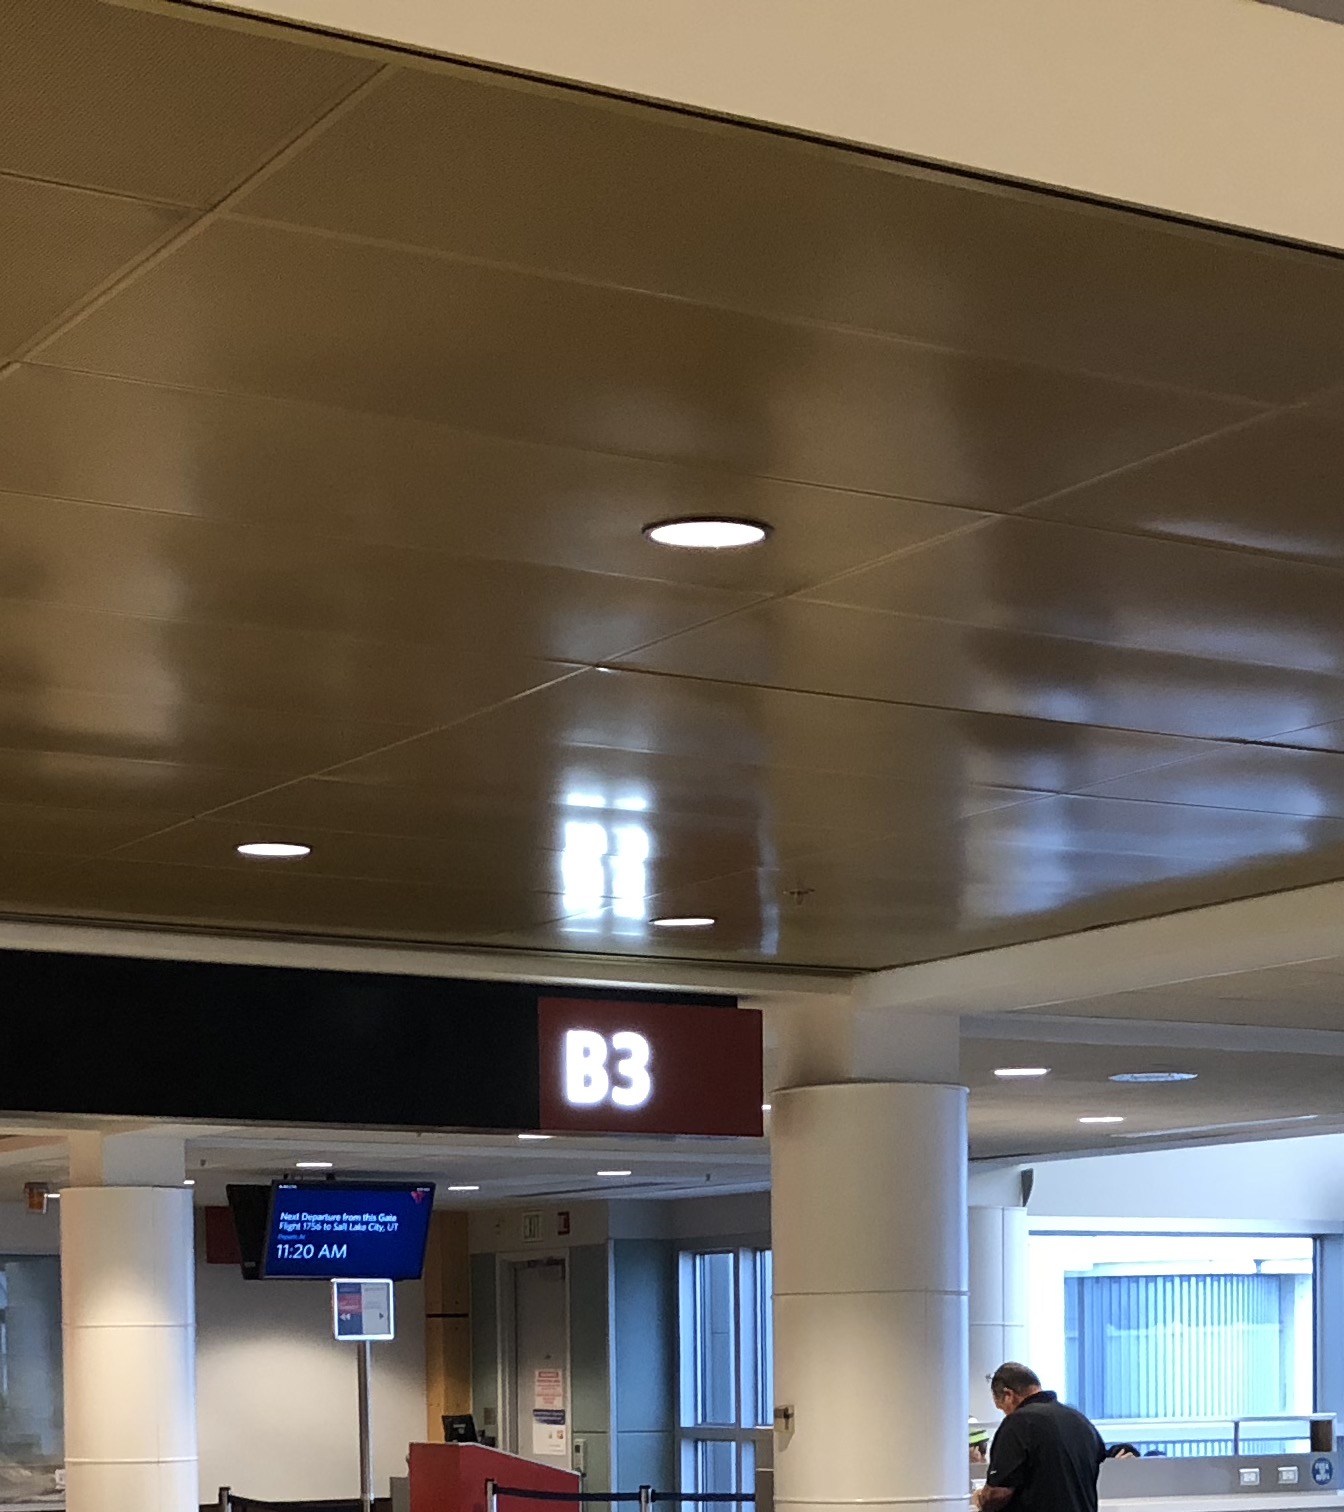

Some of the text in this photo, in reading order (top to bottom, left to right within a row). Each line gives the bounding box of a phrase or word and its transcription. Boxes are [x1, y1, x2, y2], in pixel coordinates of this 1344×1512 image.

[565, 1029, 652, 1107] B3
[280, 1212, 397, 1223] Next Departure from this Gate
[279, 1222, 301, 1232] Flight
[323, 1222, 332, 1231] to
[349, 1222, 367, 1231] Lake
[387, 1223, 399, 1232] UT
[276, 1243, 347, 1259] 11:20 AM
